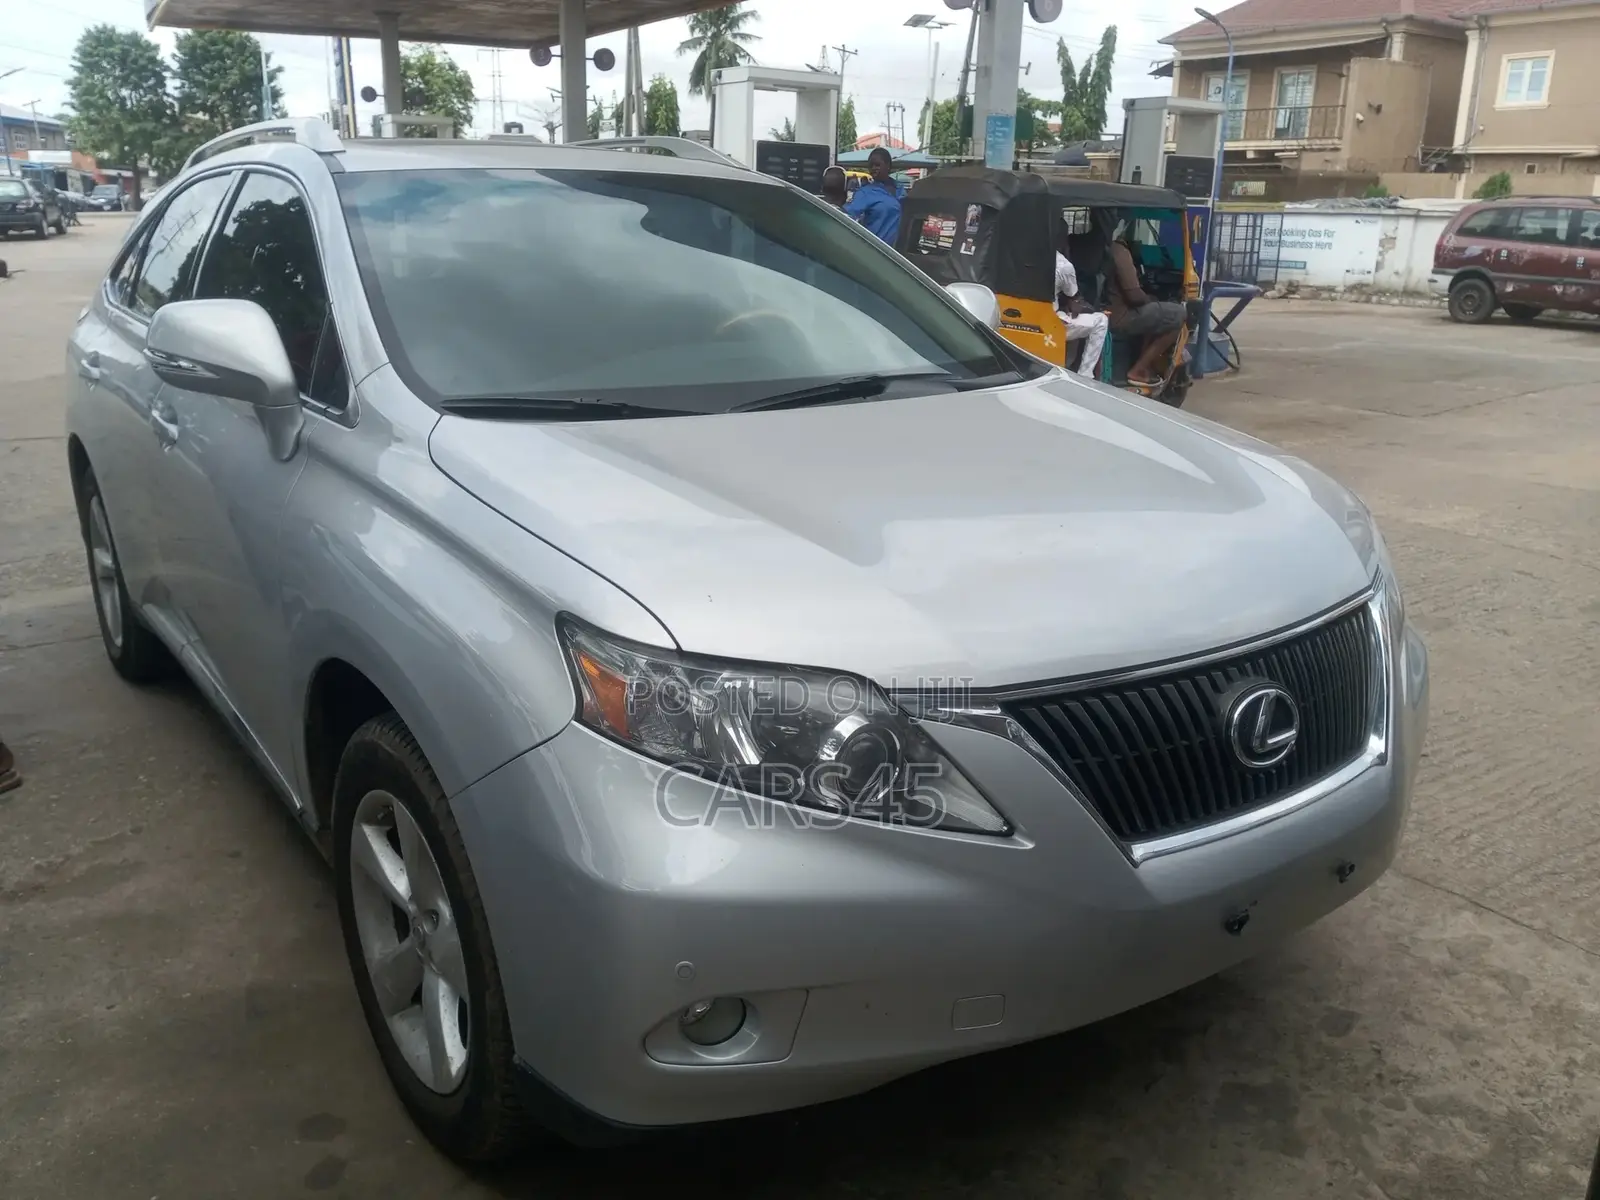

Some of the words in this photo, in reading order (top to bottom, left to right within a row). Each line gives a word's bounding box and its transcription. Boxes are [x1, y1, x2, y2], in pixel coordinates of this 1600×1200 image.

[1264, 228, 1277, 237] Get
[1308, 229, 1322, 238] Gas
[1324, 229, 1336, 238] For
[1280, 240, 1313, 249] Business
[1315, 241, 1333, 250] Here
